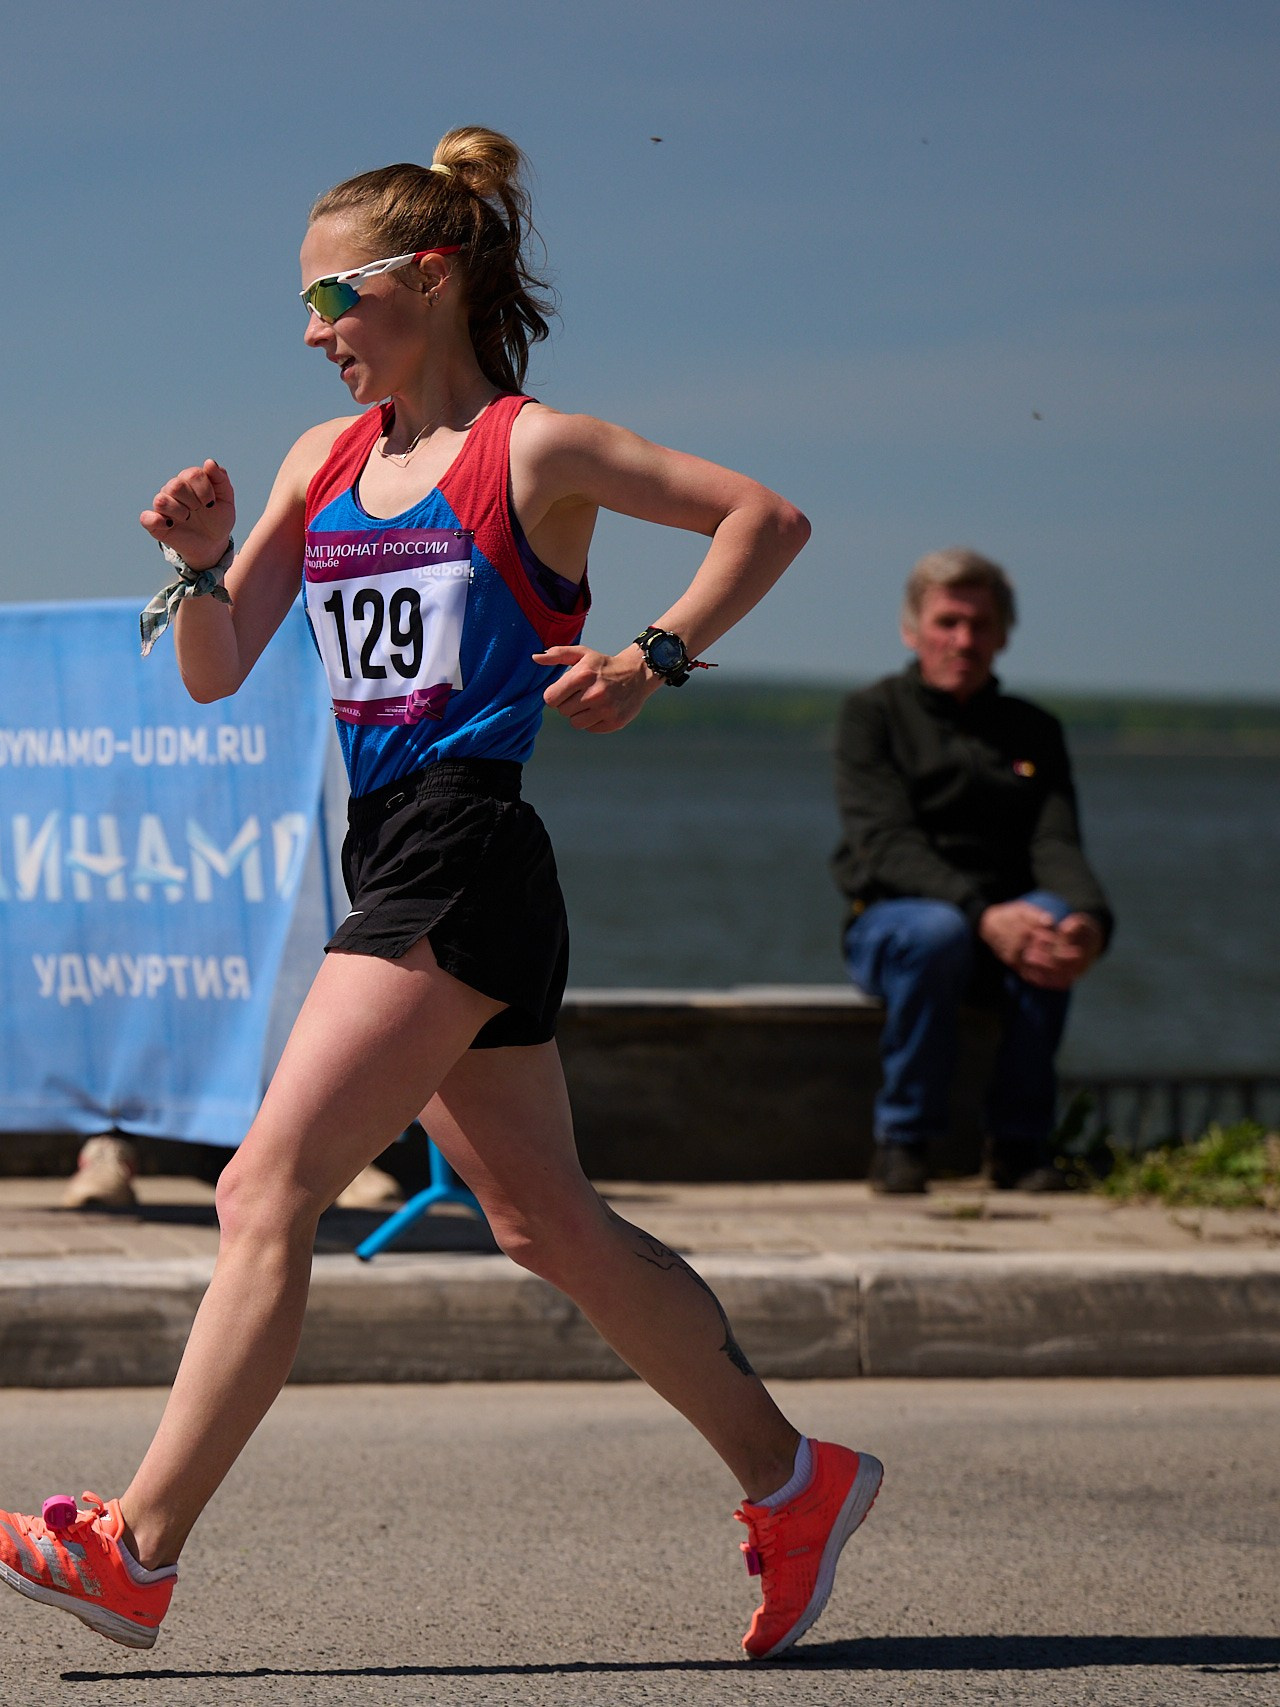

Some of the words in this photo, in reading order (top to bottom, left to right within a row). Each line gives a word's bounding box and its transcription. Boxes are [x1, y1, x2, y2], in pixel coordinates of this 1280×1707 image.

[383, 541, 449, 555] РОССИИ
[324, 587, 423, 679] 129
[32, 953, 251, 1005] УДМУРТИЯ
